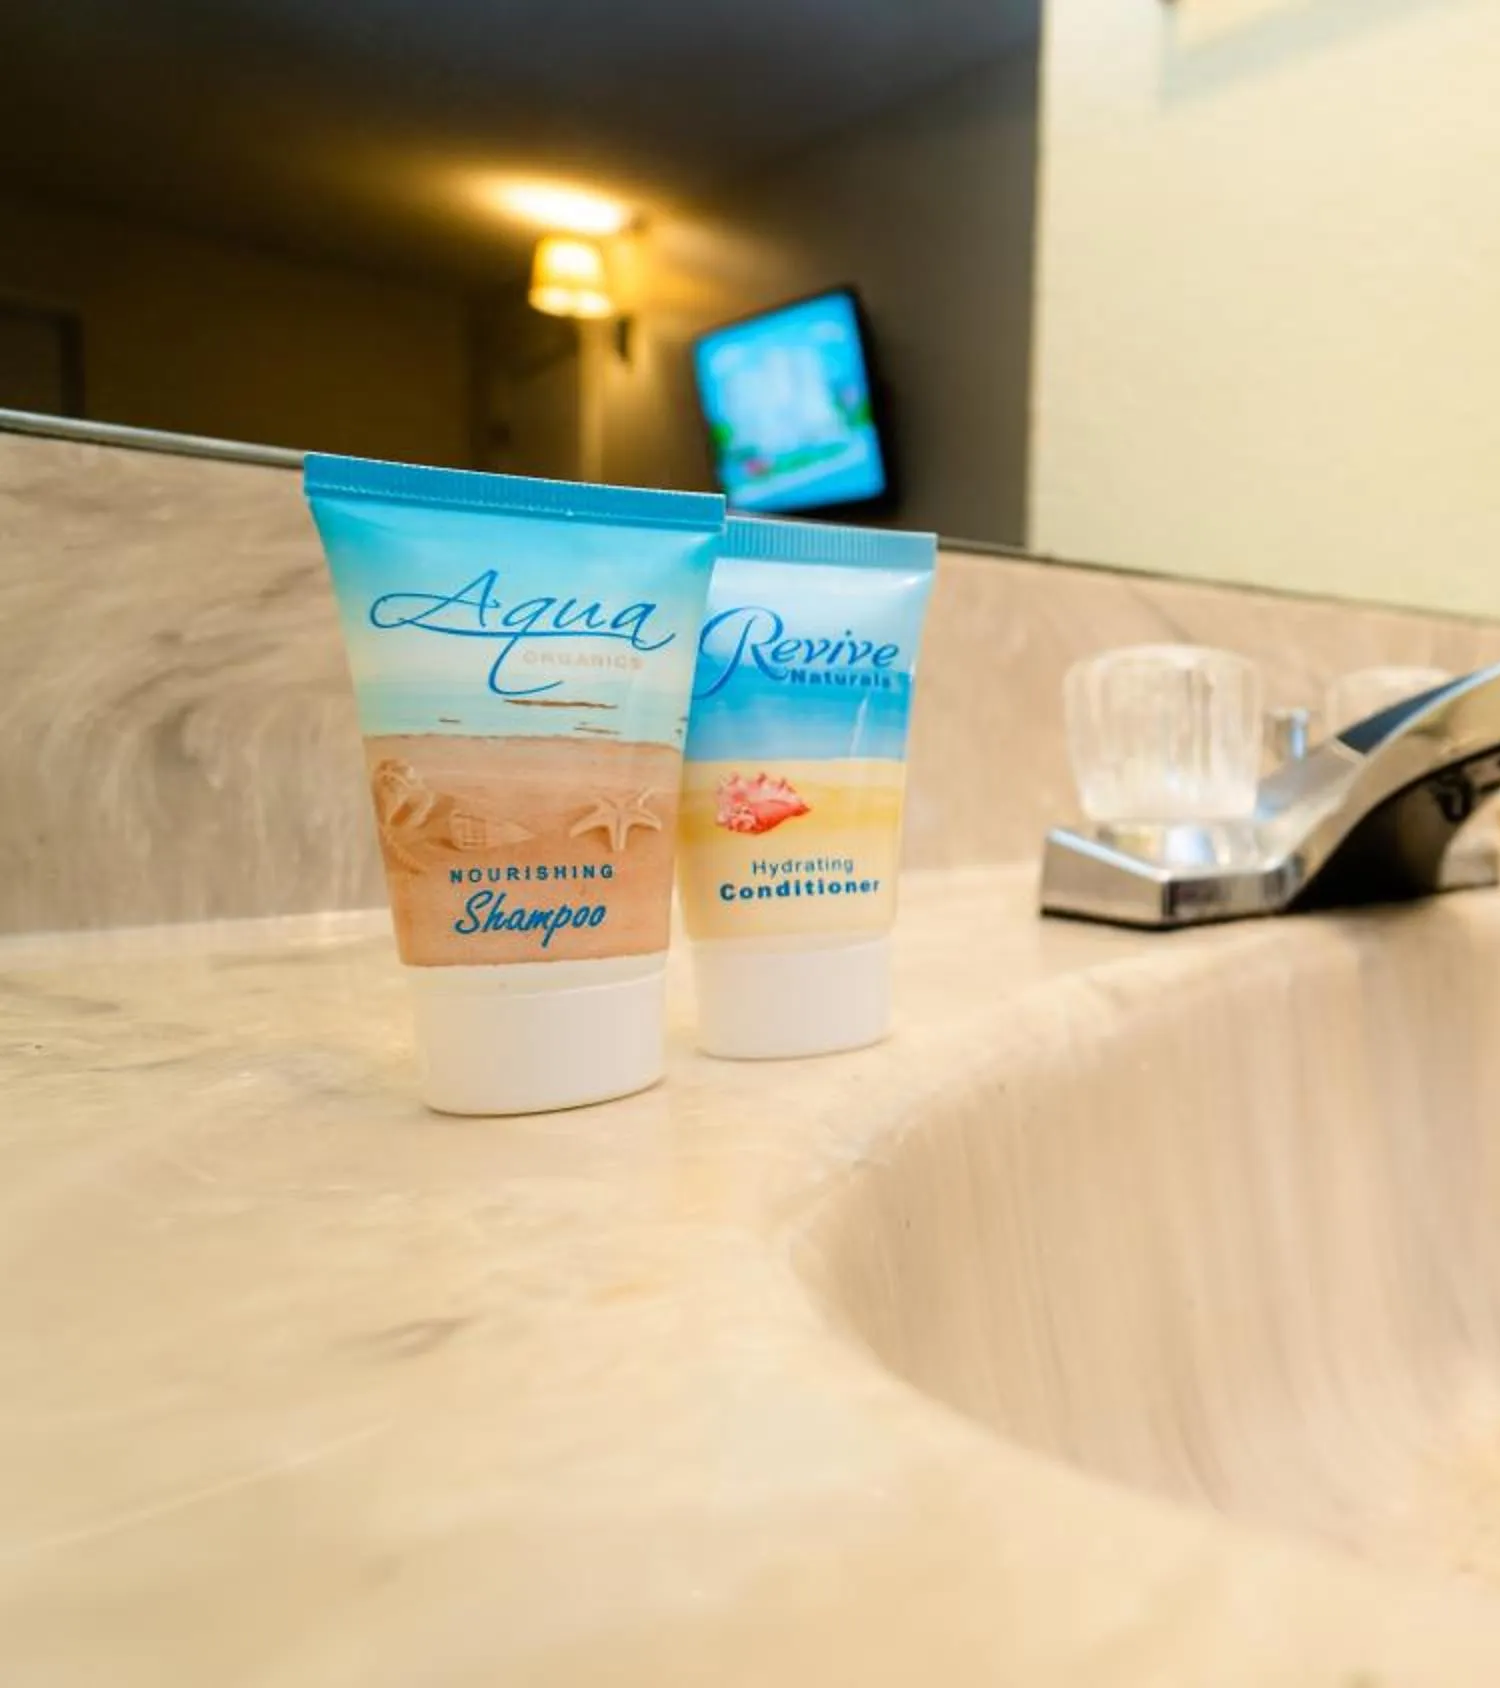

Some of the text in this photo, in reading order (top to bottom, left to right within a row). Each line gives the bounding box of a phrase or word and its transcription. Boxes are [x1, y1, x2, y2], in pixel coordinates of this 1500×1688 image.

[370, 569, 676, 695] Aqua
[523, 649, 643, 671] ORGANICS
[694, 607, 899, 698] Revive
[790, 671, 892, 689] Naturals
[450, 863, 615, 882] NOURISHING
[751, 857, 854, 876] Hydrating
[720, 878, 880, 901] Conditioner
[455, 890, 606, 947] Shampoo
